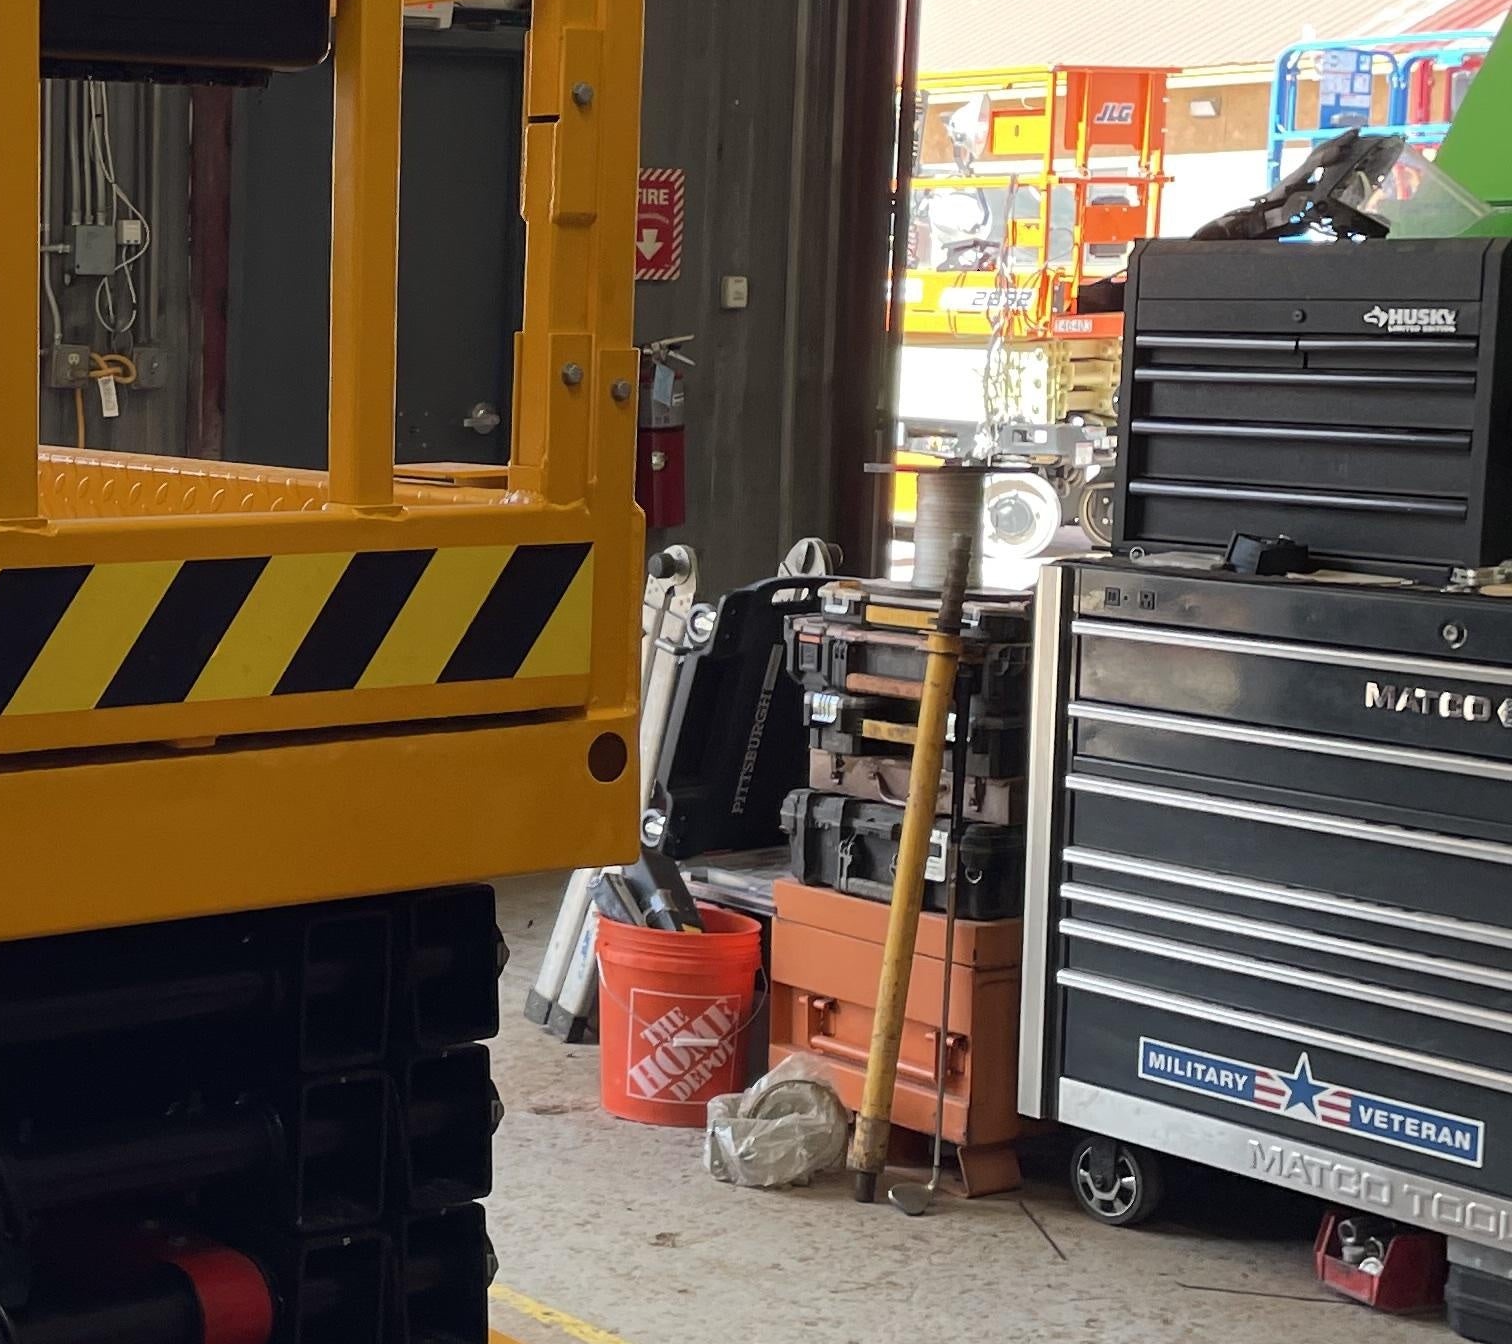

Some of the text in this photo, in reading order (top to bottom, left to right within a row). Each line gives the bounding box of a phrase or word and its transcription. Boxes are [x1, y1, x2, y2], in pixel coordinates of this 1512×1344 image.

[1095, 103, 1134, 124] JLG
[1388, 308, 1457, 325] HUSKY
[1364, 681, 1492, 722] MATCO
[731, 688, 773, 815] PITTSBURGH
[629, 997, 738, 1098] HOME
[640, 1006, 690, 1047] THE
[669, 1038, 735, 1102] DEPOT
[1148, 1051, 1471, 1151] MILITARY VETERAN
[1247, 1139, 1393, 1206] MATCO
